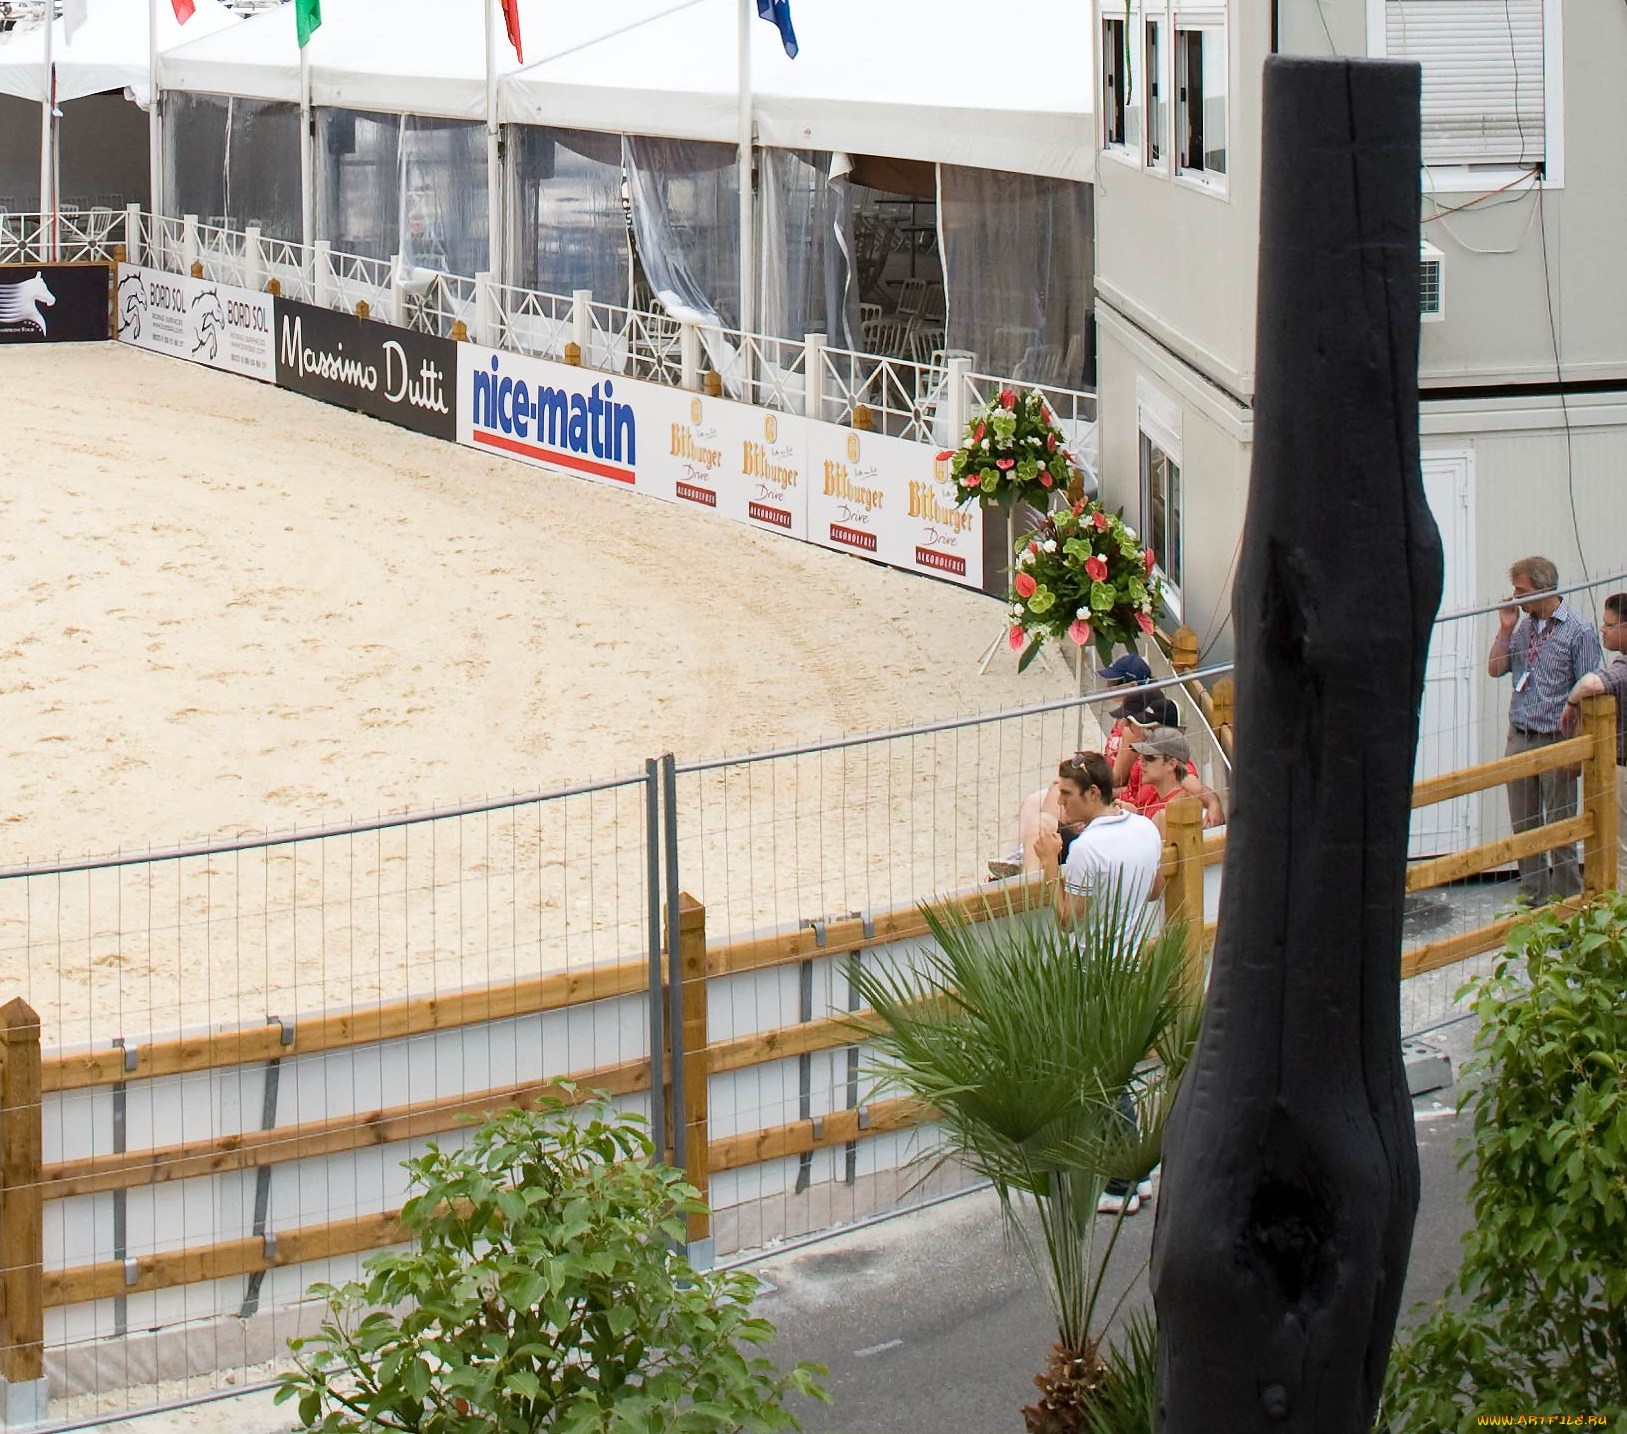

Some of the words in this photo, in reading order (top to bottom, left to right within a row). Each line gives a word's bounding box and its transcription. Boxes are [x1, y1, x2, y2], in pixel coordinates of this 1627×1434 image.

[150, 282, 170, 310] BORD
[172, 288, 187, 314] SOL
[227, 300, 250, 329] BORD
[253, 306, 269, 333] SOL
[281, 314, 378, 392] Massimo
[382, 340, 450, 415] Dutti
[473, 354, 636, 466] nice-matin
[670, 422, 722, 470] Bitburger
[742, 440, 799, 490] Bitburger
[681, 464, 710, 481] Drive
[754, 483, 784, 501] Drive
[823, 460, 884, 512] Bitburger
[836, 504, 870, 523] Drive
[907, 479, 973, 535] Bitburger
[922, 526, 957, 546] Drive
